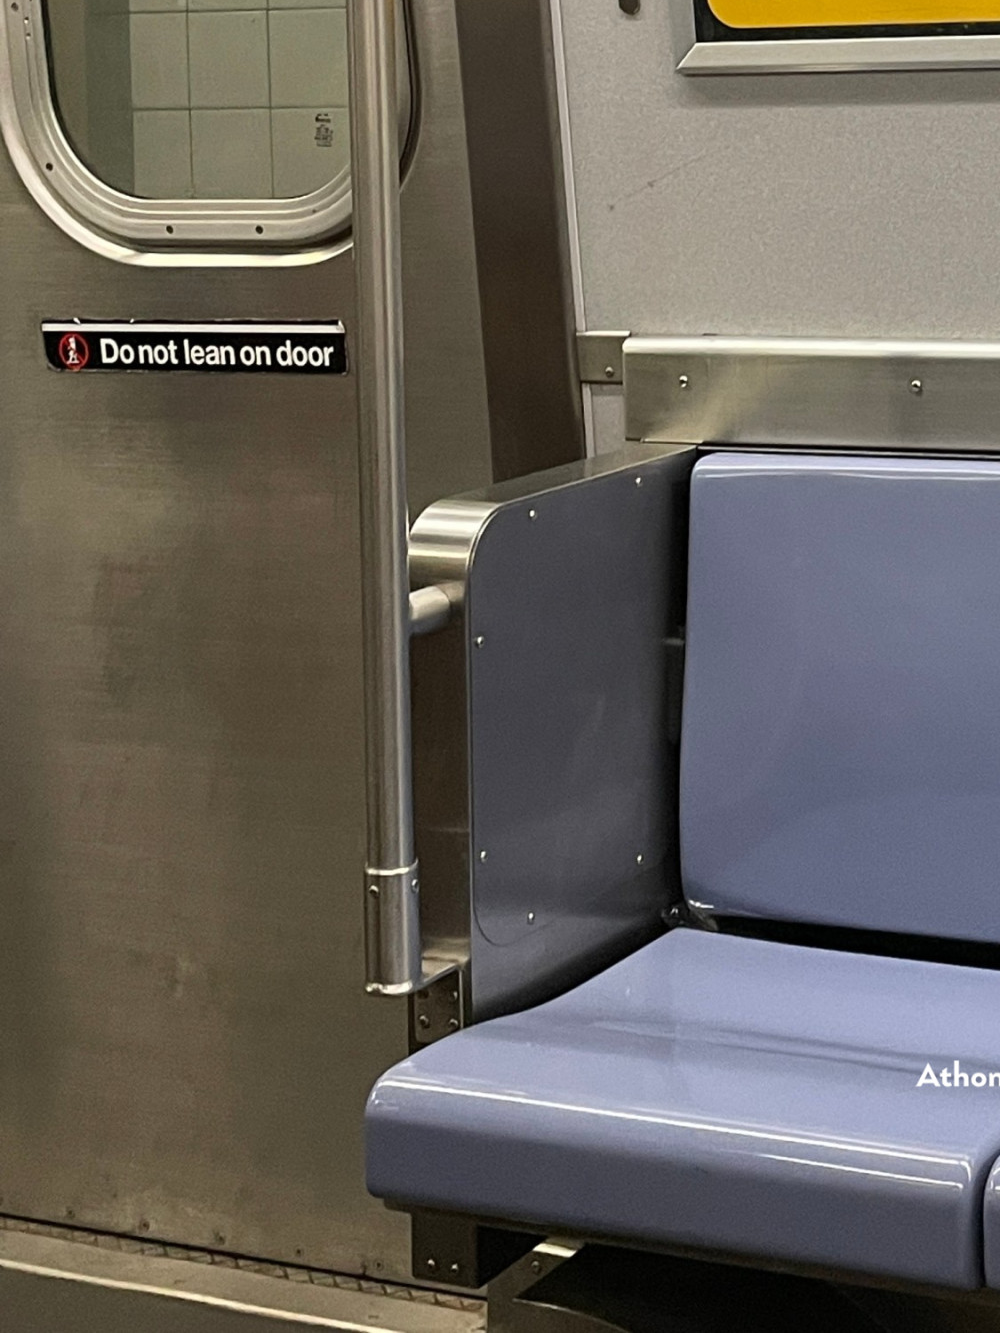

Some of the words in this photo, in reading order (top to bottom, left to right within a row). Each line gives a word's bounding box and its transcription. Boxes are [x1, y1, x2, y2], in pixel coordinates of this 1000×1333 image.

[101, 338, 134, 365] Do
[139, 341, 179, 365] not
[183, 339, 237, 367] lean
[240, 344, 271, 367] on
[275, 340, 334, 367] door
